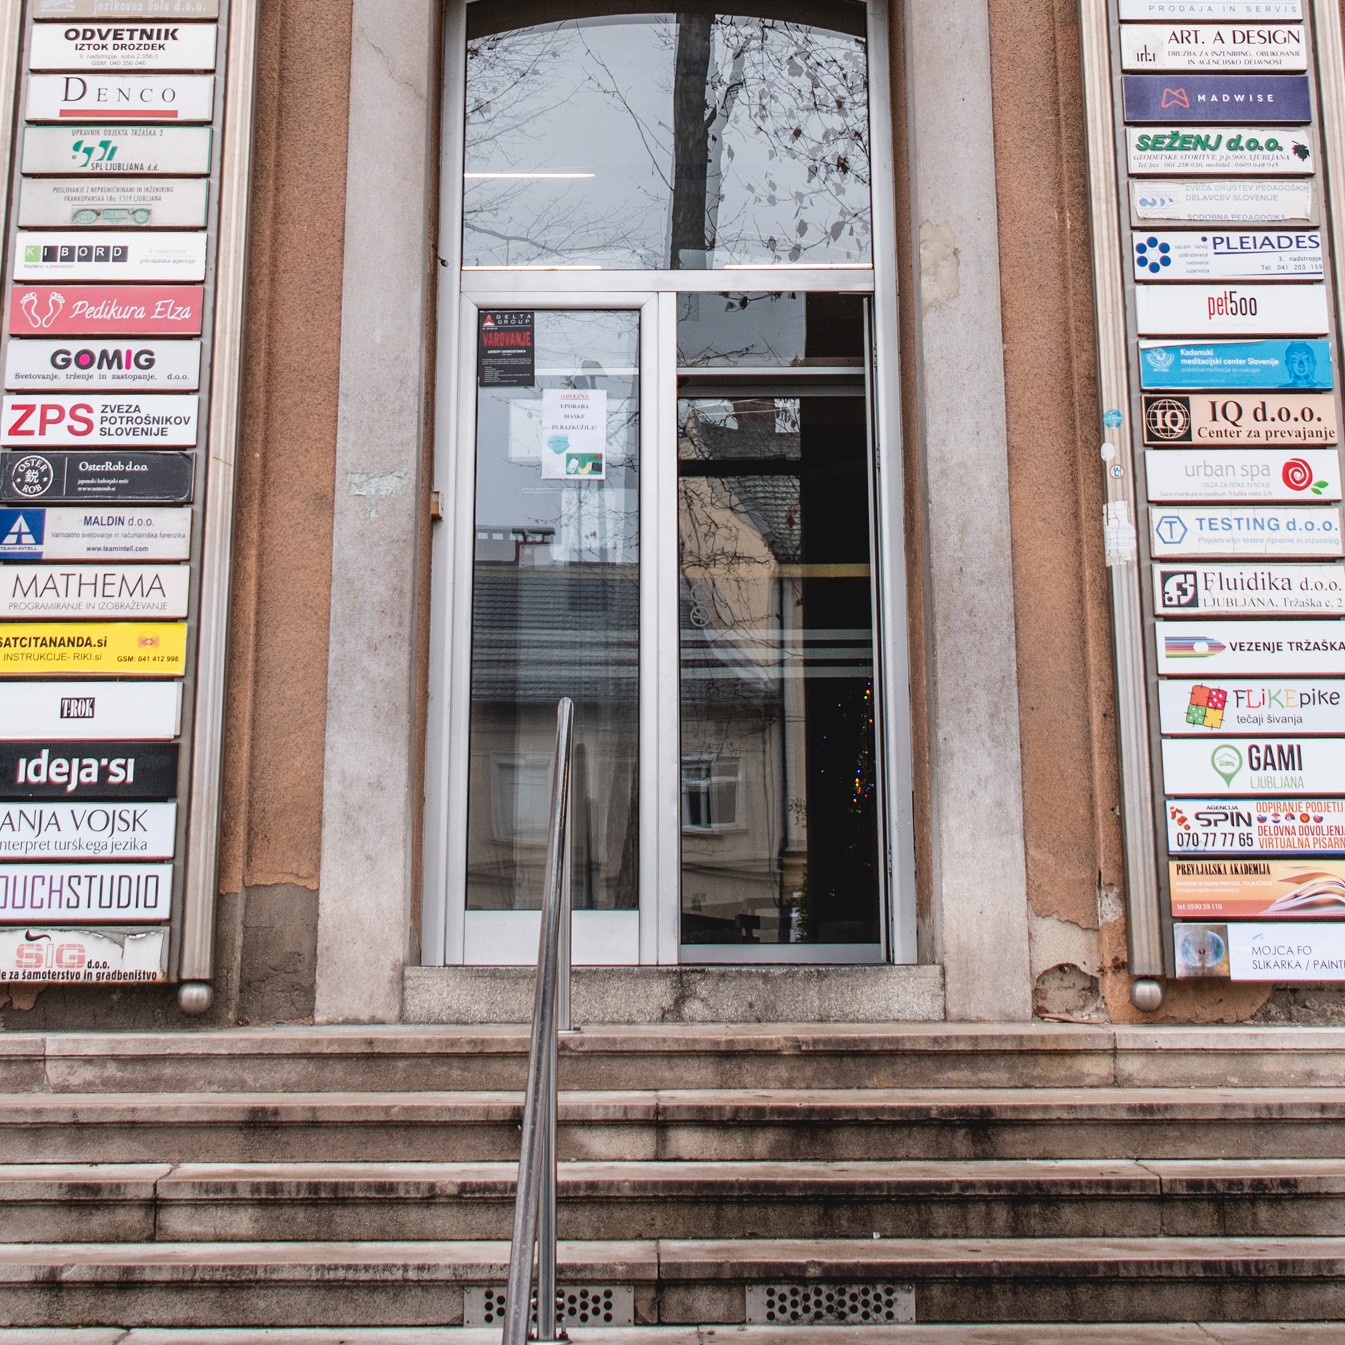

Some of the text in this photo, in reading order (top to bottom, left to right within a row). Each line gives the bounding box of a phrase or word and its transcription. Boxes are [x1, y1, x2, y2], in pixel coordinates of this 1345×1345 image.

[64, 28, 179, 40] ODVETNIK
[1168, 30, 1300, 44] ART. A DESIGN
[61, 77, 176, 103] DENCO
[1135, 131, 1222, 151] SEŽENJ
[91, 163, 144, 171] SPL LJUBLJANA
[1213, 235, 1320, 249] PLEIADES
[70, 299, 191, 320] Pedikura Elza
[483, 332, 531, 346] VAROVANJE
[51, 349, 155, 370] GOMIG
[1181, 358, 1222, 366] meditacijski
[1248, 358, 1279, 366] Slovenije
[101, 405, 140, 413] ZVEZA
[1208, 400, 1321, 426] IQ d.o.o.
[8, 403, 95, 436] ZPS
[101, 413, 190, 425] POTROŠNIKOV
[100, 427, 168, 436] SLOVENIJE
[1197, 427, 1335, 441] Center za prevajanje
[79, 461, 124, 471] OsterRob
[1185, 461, 1270, 481] urban spa
[84, 516, 125, 526] MALDIN
[1196, 518, 1338, 531] TESTING d.o.o.
[12, 573, 166, 598] MATHEMA
[1202, 572, 1292, 591] Fluidika
[99, 600, 167, 610] IZOBRAŽEVANJE
[1230, 639, 1345, 652] VEZENJE TRŽAŠKA
[1237, 714, 1302, 725] tečaji šivanja
[1248, 744, 1303, 771] GAMI
[1250, 776, 1304, 789] LJUBLJANA
[1256, 802, 1303, 813] ODPIRANJE
[0, 809, 148, 838] ANJA VOJSK
[1195, 812, 1252, 827] SPIN
[1258, 826, 1296, 836] DELOVNA
[54, 837, 107, 854] turškega
[110, 838, 147, 853] jezika
[1177, 833, 1253, 846] 070 77 77 65
[1259, 837, 1311, 849] VIRTUALNA
[1176, 863, 1270, 875] PREVAJALSKA AKADEMIJA
[16, 943, 85, 968] SIG
[1252, 946, 1312, 956] MOJCA FO
[1252, 960, 1302, 970] SLIKARKA
[9, 971, 18, 979] za
[95, 969, 156, 981] gradbeništvo
